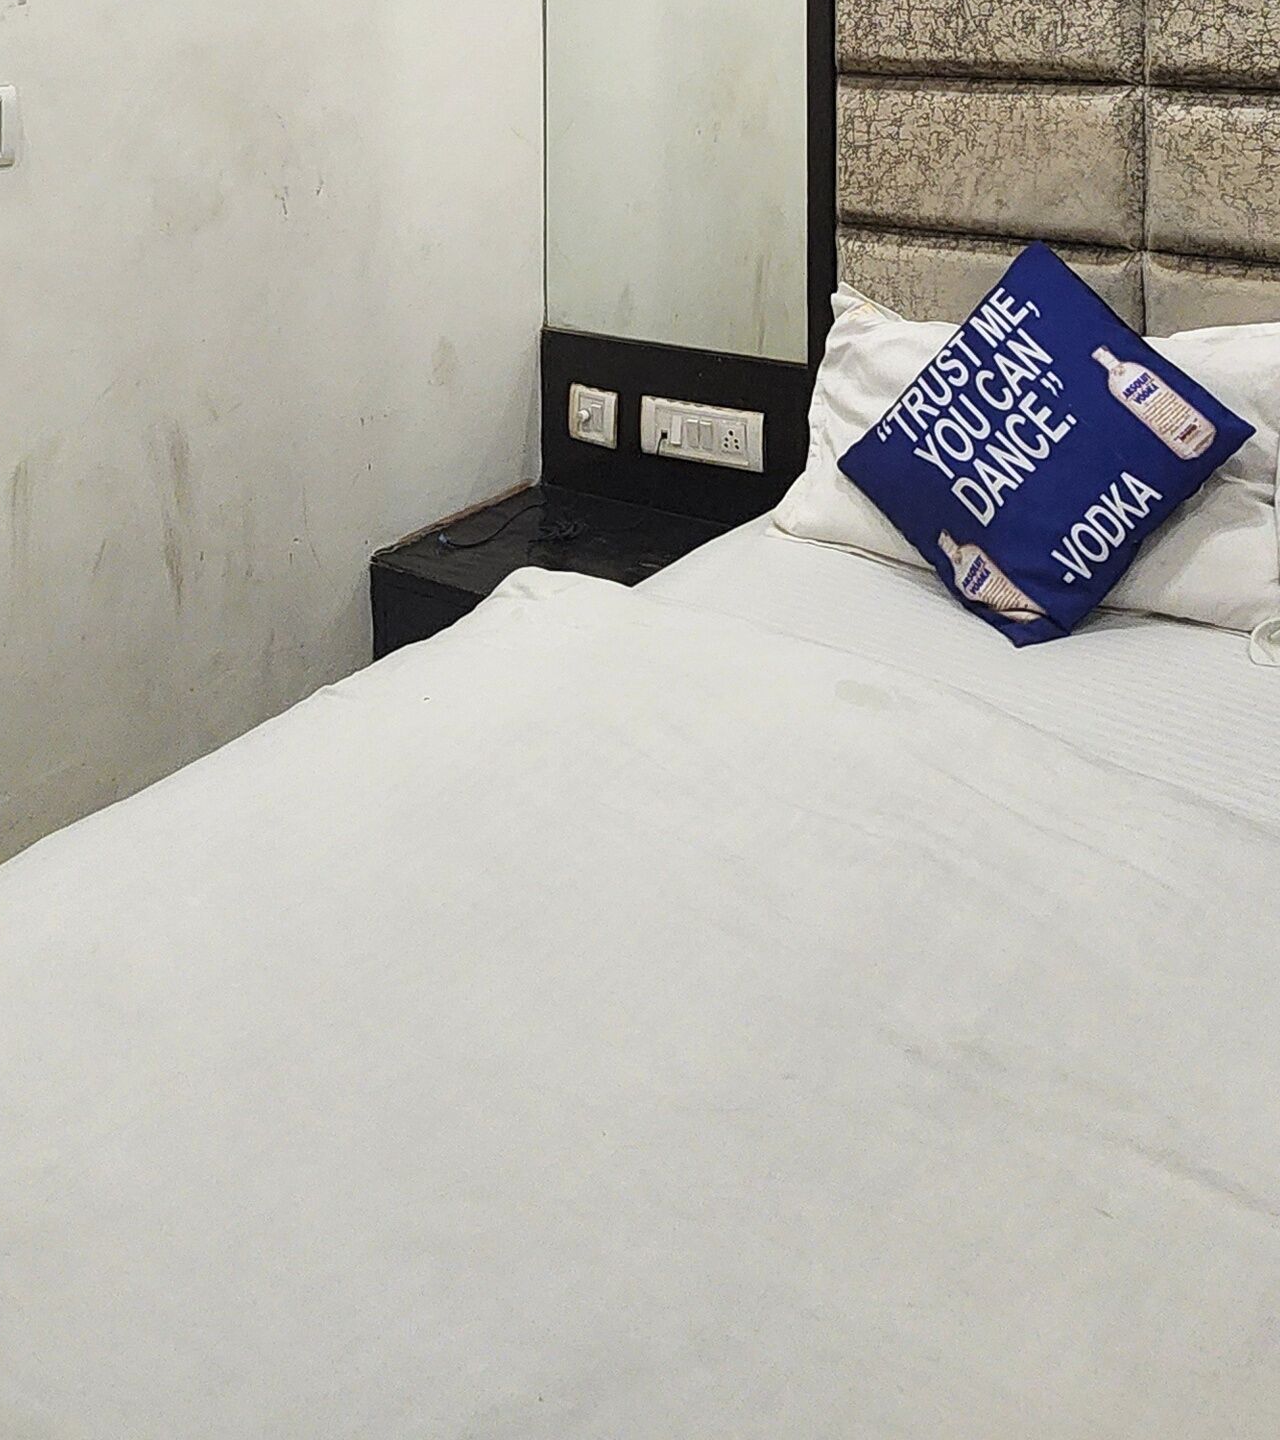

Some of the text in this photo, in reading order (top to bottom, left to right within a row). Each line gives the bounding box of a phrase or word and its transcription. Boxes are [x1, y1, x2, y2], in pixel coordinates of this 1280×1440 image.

[968, 287, 1041, 348] ME,
[913, 328, 1055, 480] YOU CAN
